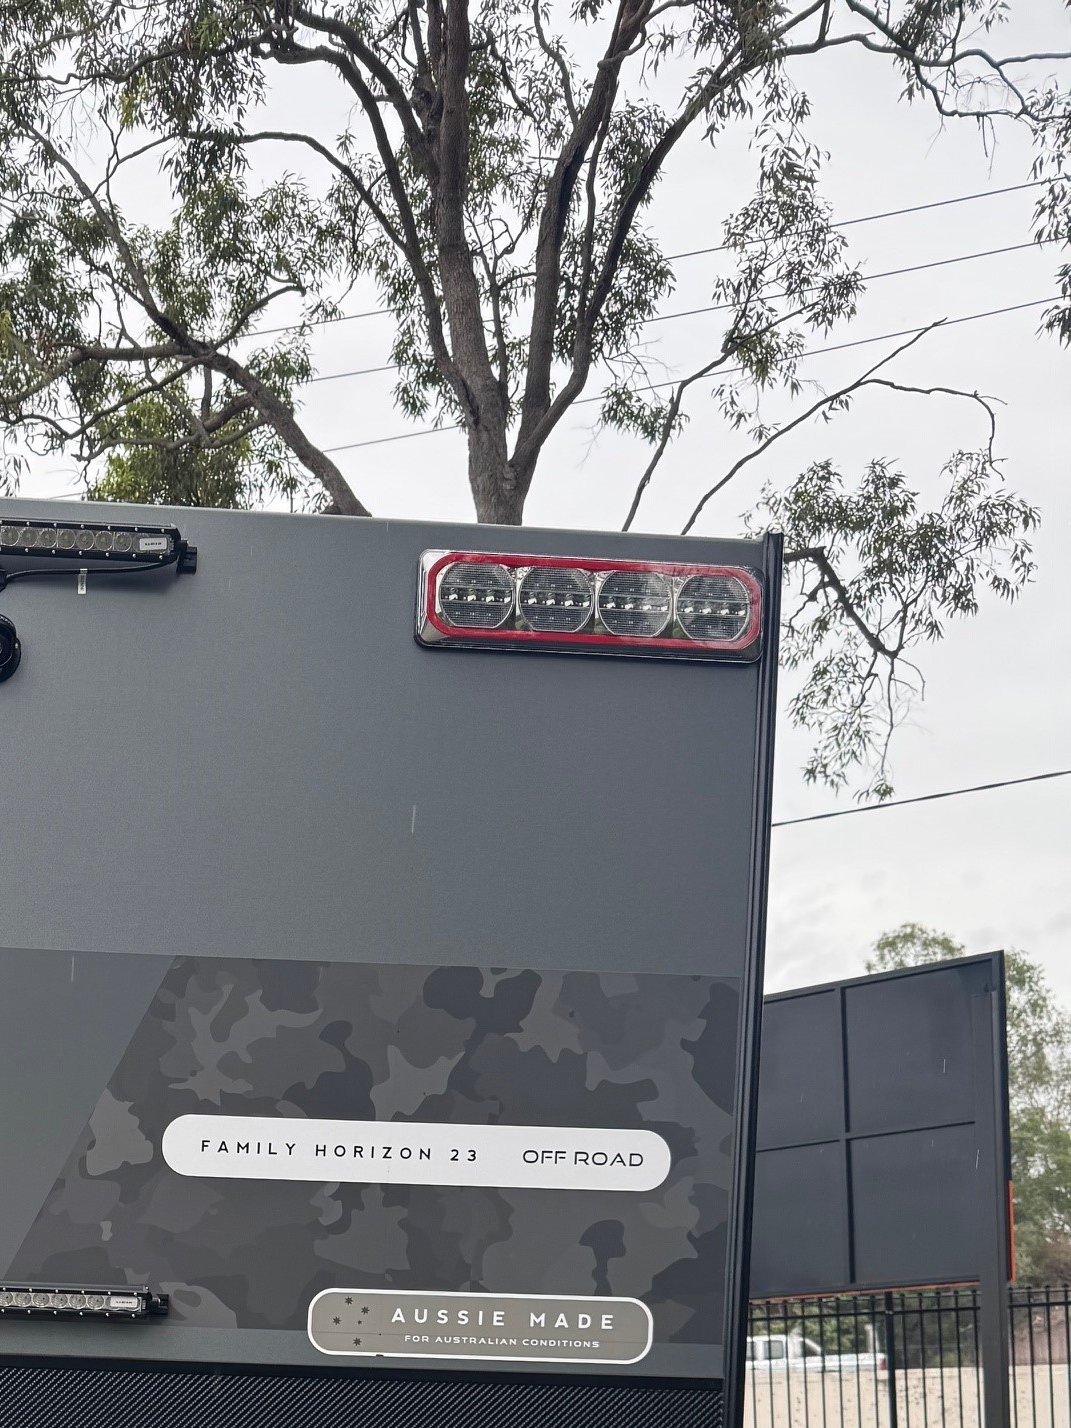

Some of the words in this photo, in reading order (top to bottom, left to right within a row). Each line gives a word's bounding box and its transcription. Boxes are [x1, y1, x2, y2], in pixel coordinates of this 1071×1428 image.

[201, 1139, 296, 1156] FAMILY
[315, 1144, 431, 1160] HORIZON
[450, 1148, 477, 1162] 23
[522, 1149, 567, 1165] OFF
[573, 1151, 644, 1167] ROAD
[391, 1307, 505, 1326] AUSSIE
[529, 1312, 614, 1330] MADE
[404, 1334, 430, 1343] FOR
[434, 1336, 517, 1346] AUSTRALIAN
[522, 1338, 600, 1348] CONDITIONS
